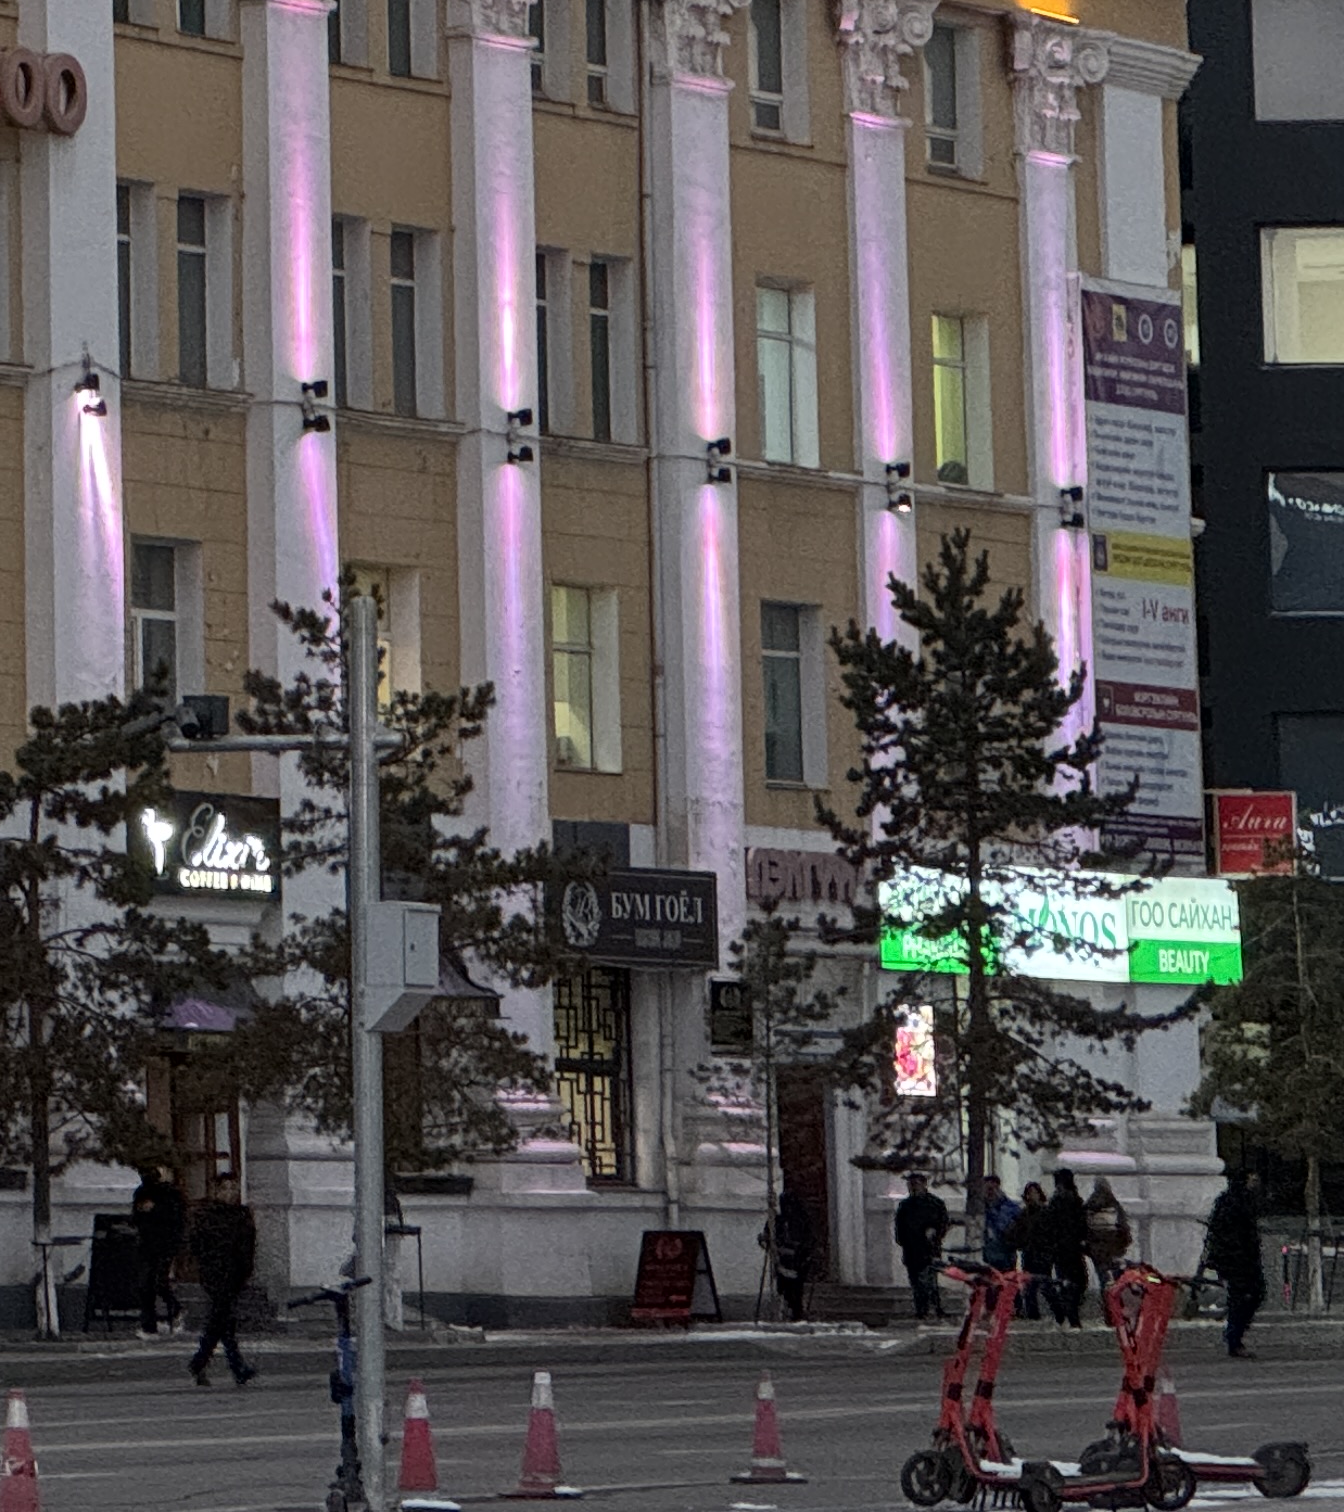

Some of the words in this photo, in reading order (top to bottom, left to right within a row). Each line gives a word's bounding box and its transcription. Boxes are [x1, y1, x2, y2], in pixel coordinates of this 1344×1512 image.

[181, 802, 271, 872] Elixir
[179, 868, 229, 890] COFFEE
[611, 891, 651, 921] БУМ
[655, 889, 703, 924] ГОЁЛ
[1131, 900, 1164, 928] ГОО
[1168, 897, 1233, 930] САЙХАН
[1158, 949, 1210, 974] BEAUTY
